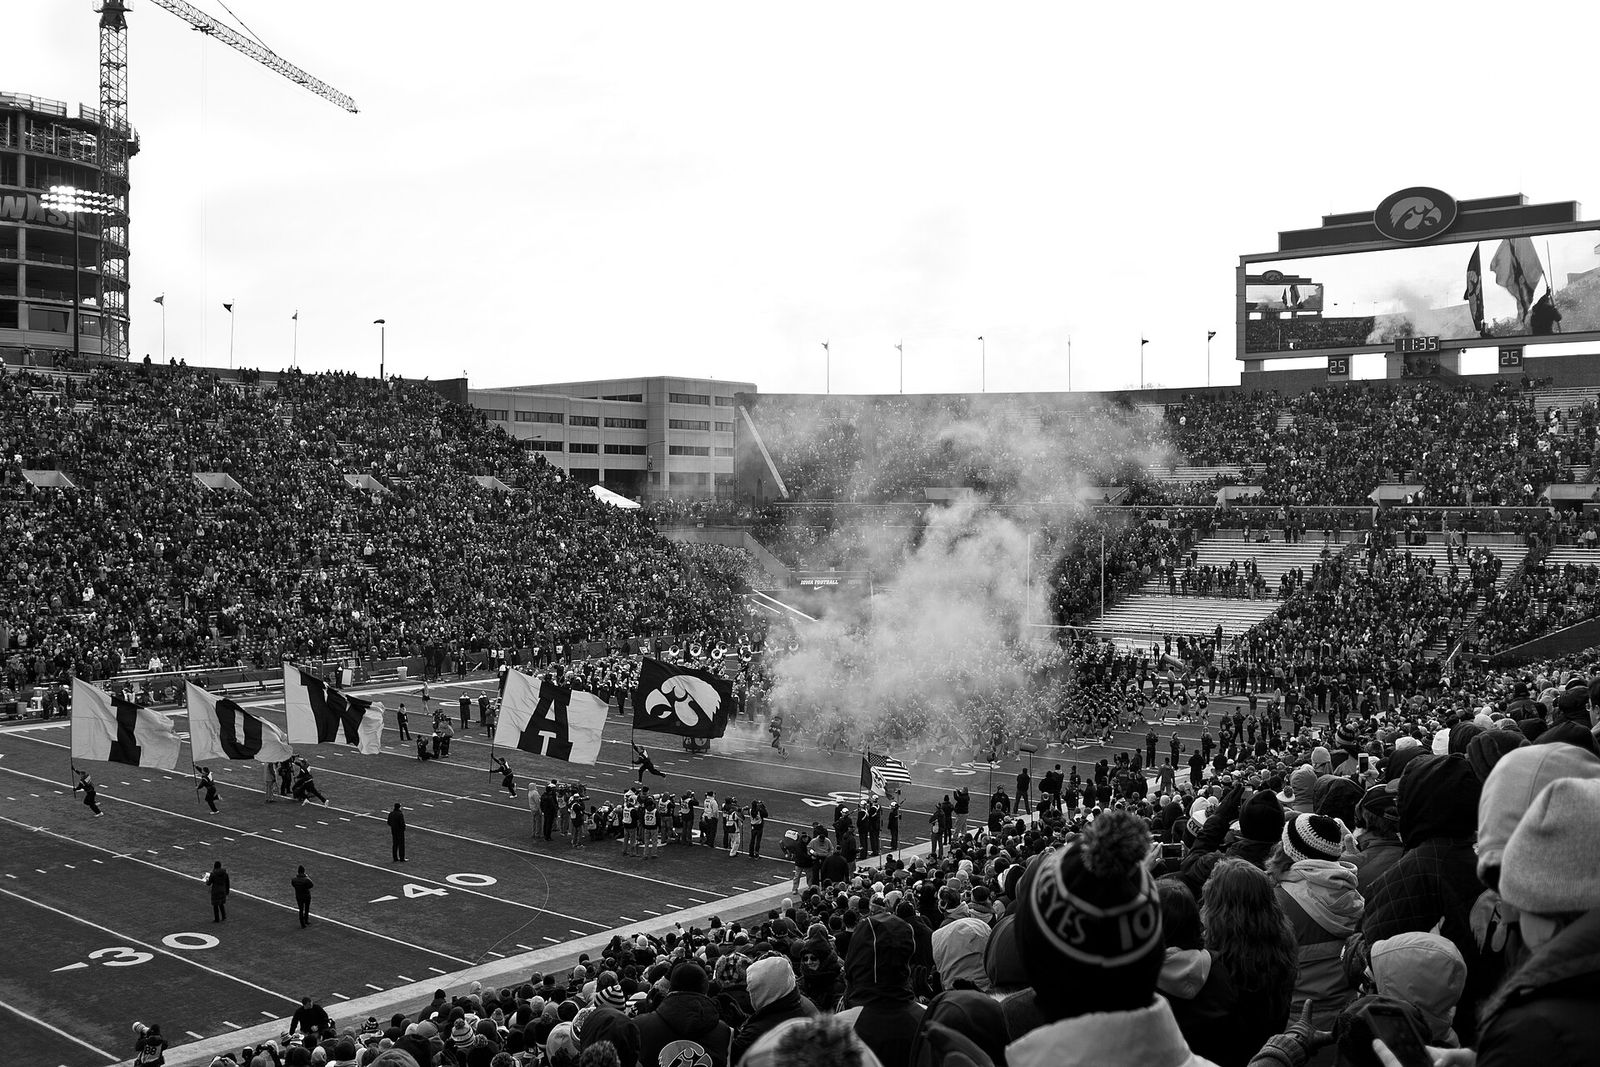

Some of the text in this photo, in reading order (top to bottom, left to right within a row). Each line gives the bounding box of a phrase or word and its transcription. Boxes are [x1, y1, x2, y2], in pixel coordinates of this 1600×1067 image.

[1402, 337, 1436, 351] 11:35
[1501, 351, 1519, 365] 25
[1329, 360, 1346, 373] 25
[300, 671, 372, 747] W
[517, 680, 574, 762] A
[108, 696, 147, 768] I
[402, 873, 498, 899] 40
[88, 932, 220, 967] 30
